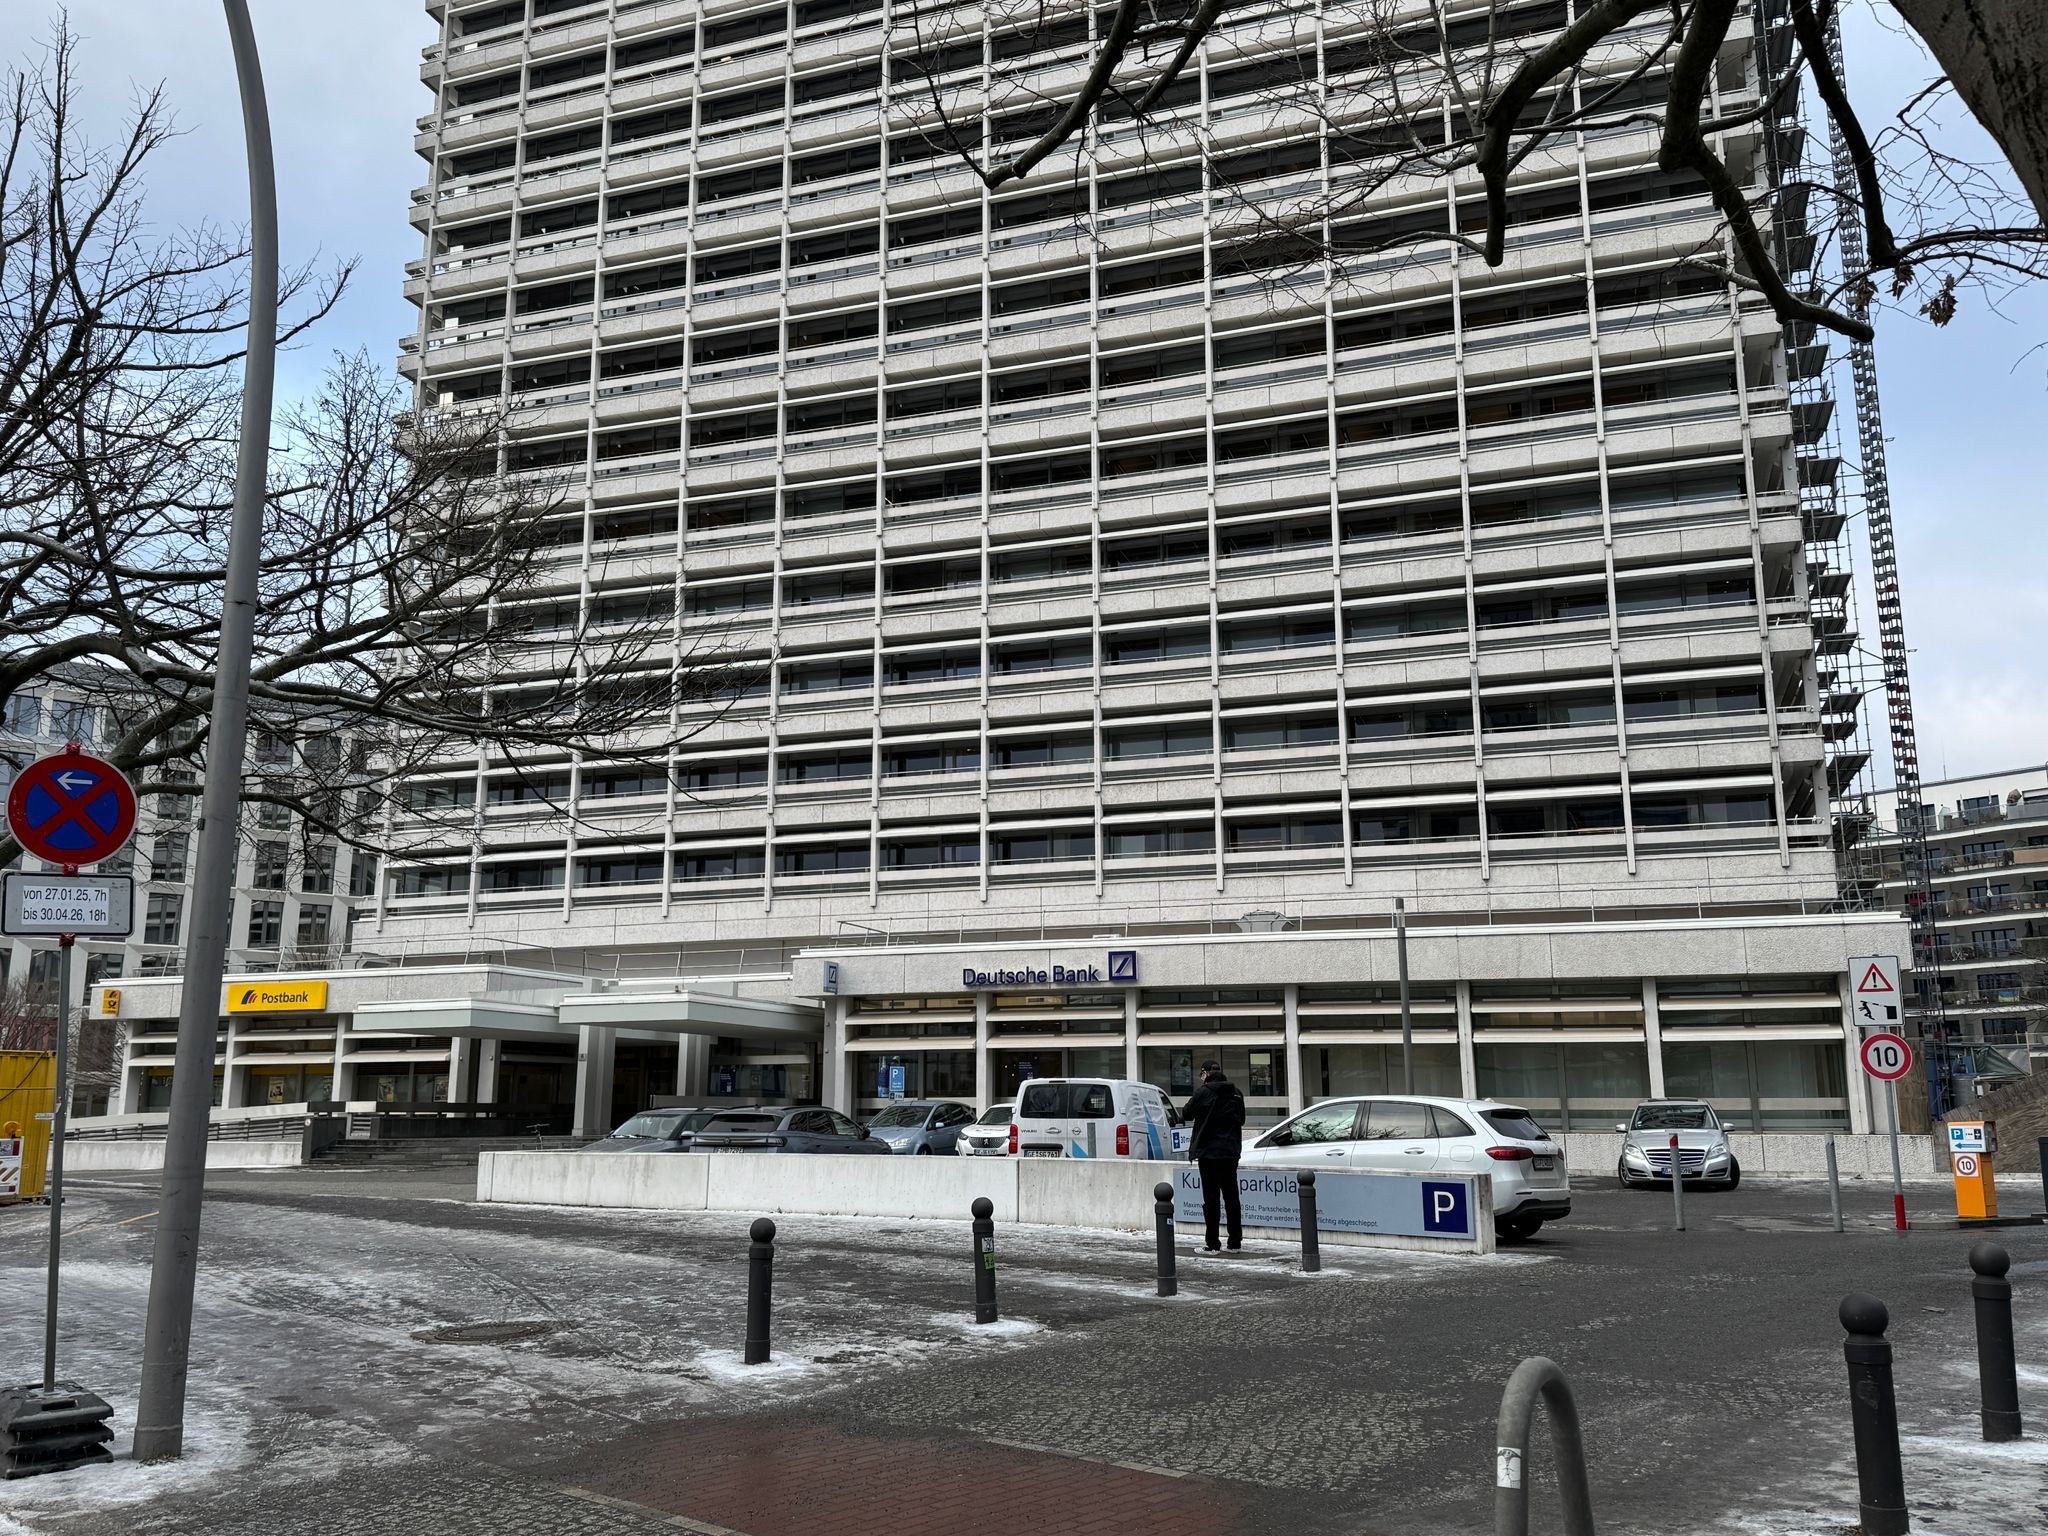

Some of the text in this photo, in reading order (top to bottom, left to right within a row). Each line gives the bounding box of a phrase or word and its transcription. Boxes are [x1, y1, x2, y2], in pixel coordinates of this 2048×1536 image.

[24, 888, 107, 902] von 27.01.25, 7h
[23, 907, 107, 922] bis 30.04.26, 18h
[963, 964, 1100, 985] Deutsche Bank
[261, 991, 308, 1004] Postbank
[1873, 1046, 1898, 1067] 10
[893, 1069, 898, 1078] P
[1953, 1130, 1961, 1139] P
[1961, 1161, 1972, 1171] 10
[1258, 1205, 1291, 1213] Parkscheibe
[1433, 1190, 1455, 1223] P
[1245, 1212, 1272, 1221] Fahrzeuge
